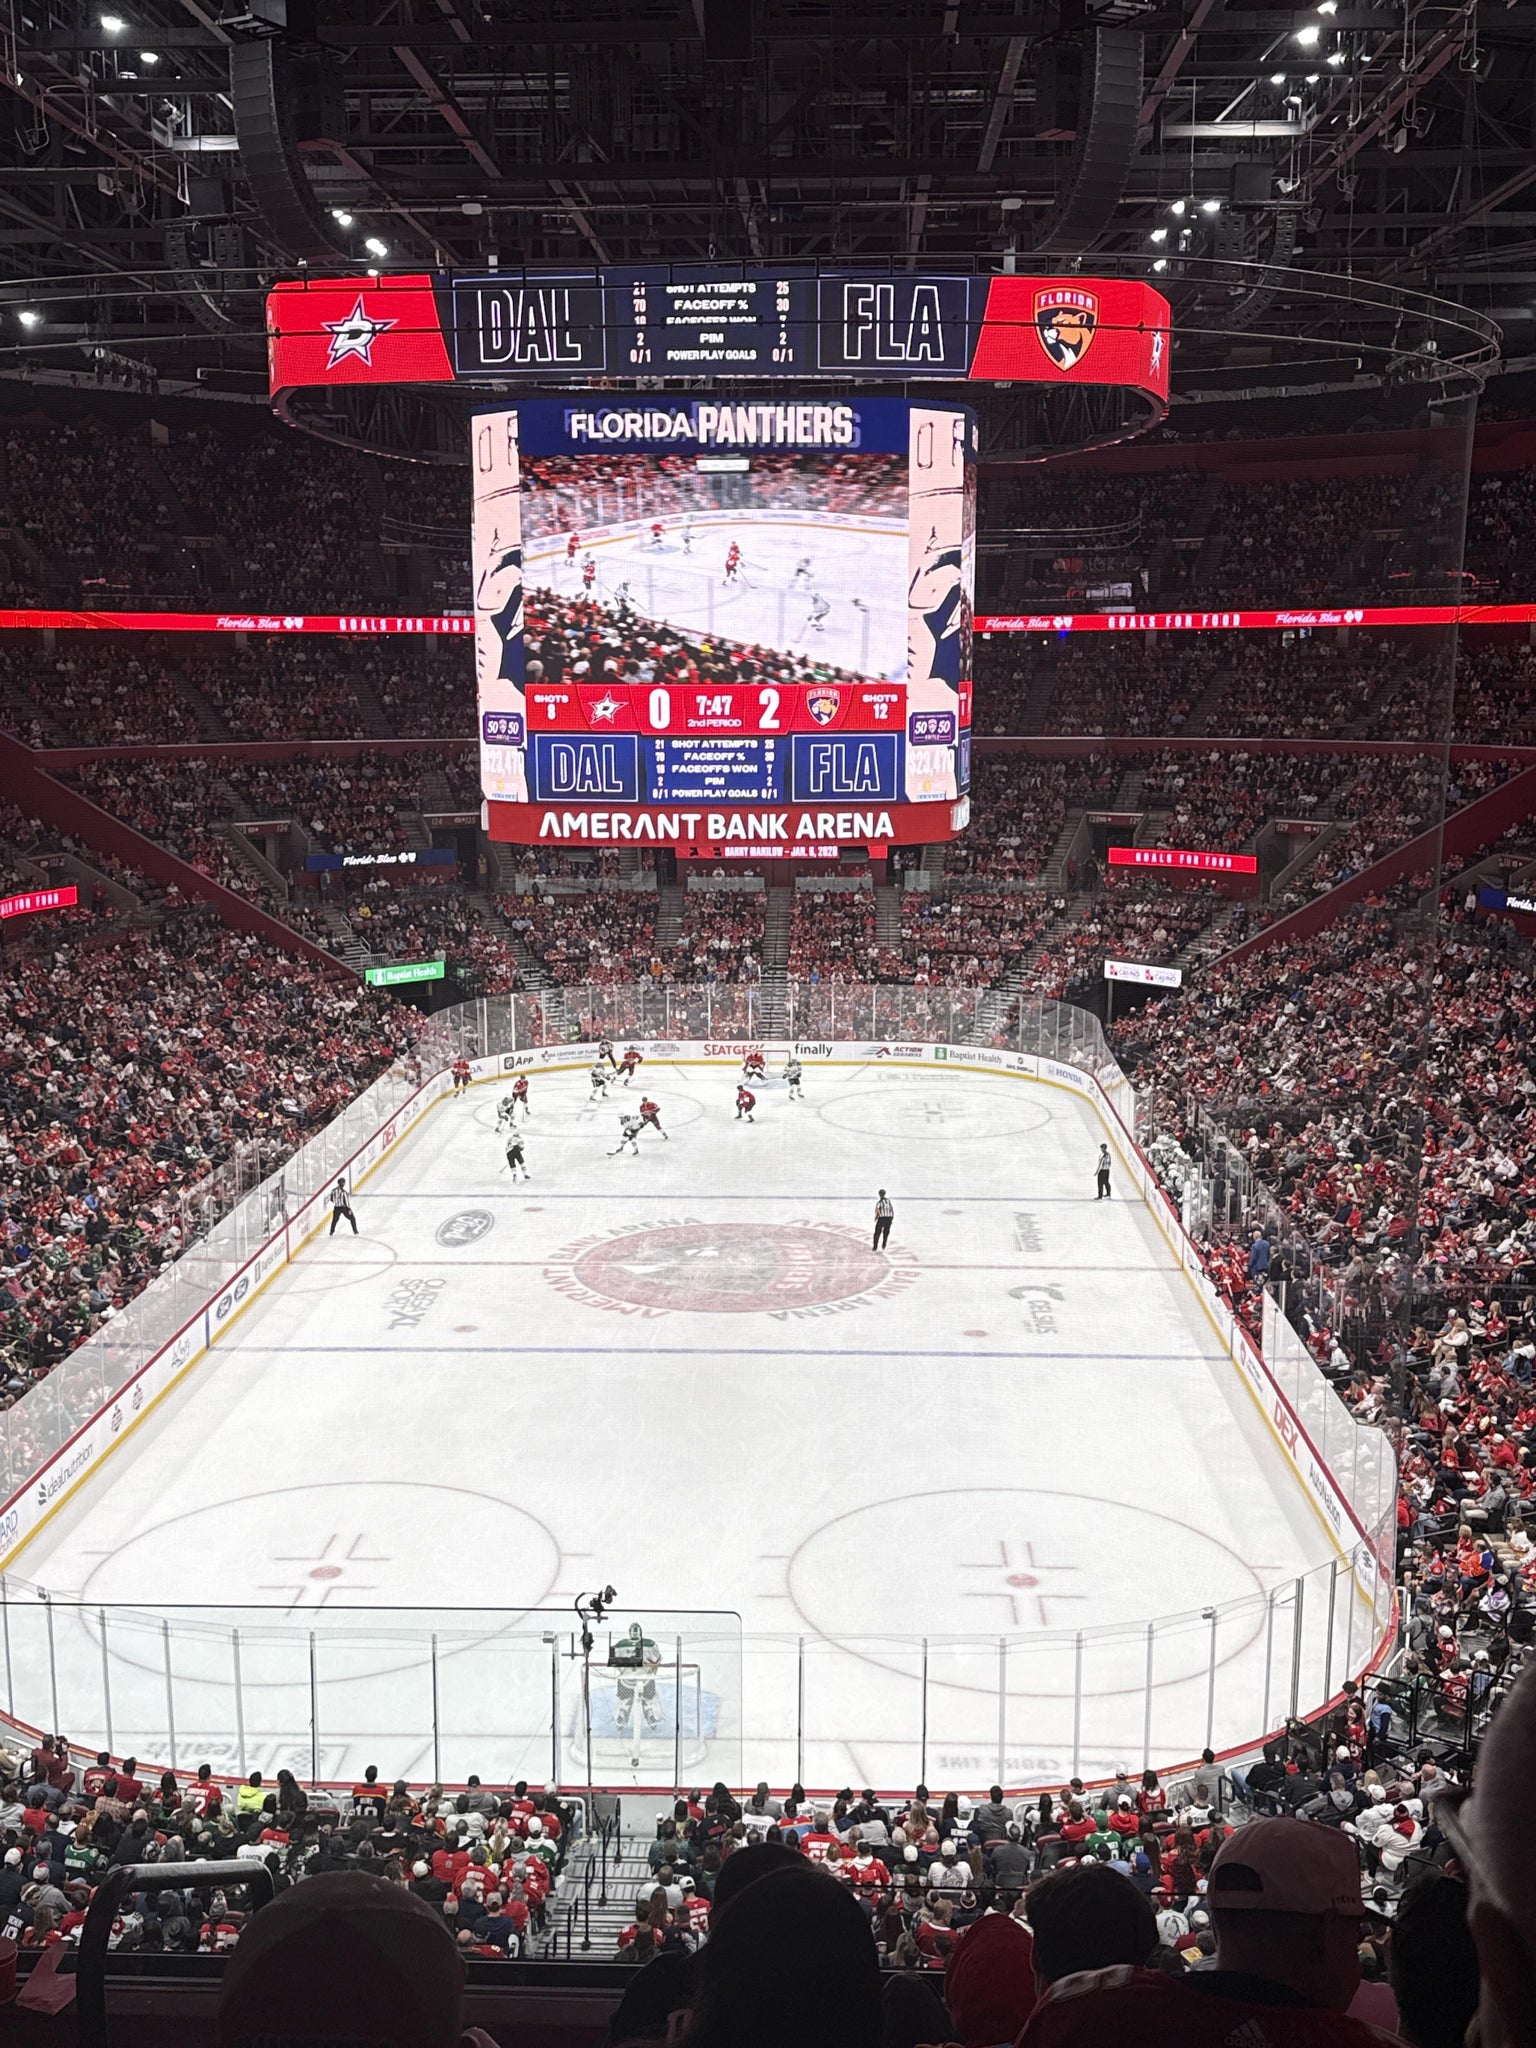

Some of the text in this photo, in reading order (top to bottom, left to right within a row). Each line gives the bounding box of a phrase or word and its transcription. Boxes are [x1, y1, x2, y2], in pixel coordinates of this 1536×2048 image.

[697, 282, 757, 294] ATTEMPTS
[776, 281, 789, 295] 25
[633, 299, 646, 312] 70
[674, 299, 748, 311] FACEOFF %
[776, 299, 789, 312] 30
[1040, 291, 1093, 308] FLORIDA
[477, 289, 582, 363] DAL
[844, 284, 944, 362] FLA
[637, 332, 644, 345] 2
[700, 333, 724, 343] PIM
[779, 332, 786, 345] 2
[630, 349, 651, 363] 0/1
[667, 349, 757, 360] POWER PLAY GOALS
[772, 348, 793, 362] 0/1
[572, 406, 853, 444] FLORIDA PANTHERS
[216, 617, 255, 629] Florida
[985, 618, 1050, 630] Florida Blue
[1108, 614, 1241, 629] GOALS FOR FOOD
[1275, 611, 1341, 624] Florida Blue
[339, 618, 471, 632] GOALS FOR FOOD
[534, 694, 569, 703] SHOTS
[696, 695, 733, 715] 7:47
[862, 694, 898, 703] SHOTS
[650, 688, 671, 729] 0
[759, 688, 780, 729] 2
[873, 703, 888, 719] 12
[487, 720, 519, 734] 50 50
[688, 718, 742, 727] 2nd PERIOD
[914, 720, 950, 735] 50 50
[655, 739, 665, 749] 21
[671, 740, 758, 748] SHOT ATTEMPTS
[684, 752, 735, 761] FACEOFF
[551, 744, 623, 793] DAL
[671, 765, 758, 773] FACEOFFS WON
[767, 764, 773, 774] 7
[811, 743, 881, 793] FLA
[658, 776, 664, 786] 2
[704, 777, 725, 785] PIM
[767, 776, 773, 786] 2
[671, 789, 758, 798] POWER PLAY GOALS
[539, 811, 895, 840] AMERANT BANK ARENA
[1135, 852, 1173, 864] GOALS
[1179, 853, 1199, 865] FOR
[795, 1043, 833, 1057] finally
[949, 1050, 1003, 1064] Baptist Health
[1056, 1068, 1083, 1085] HONDA
[768, 1296, 874, 1322] ARENA
[1274, 1398, 1299, 1461] DEX
